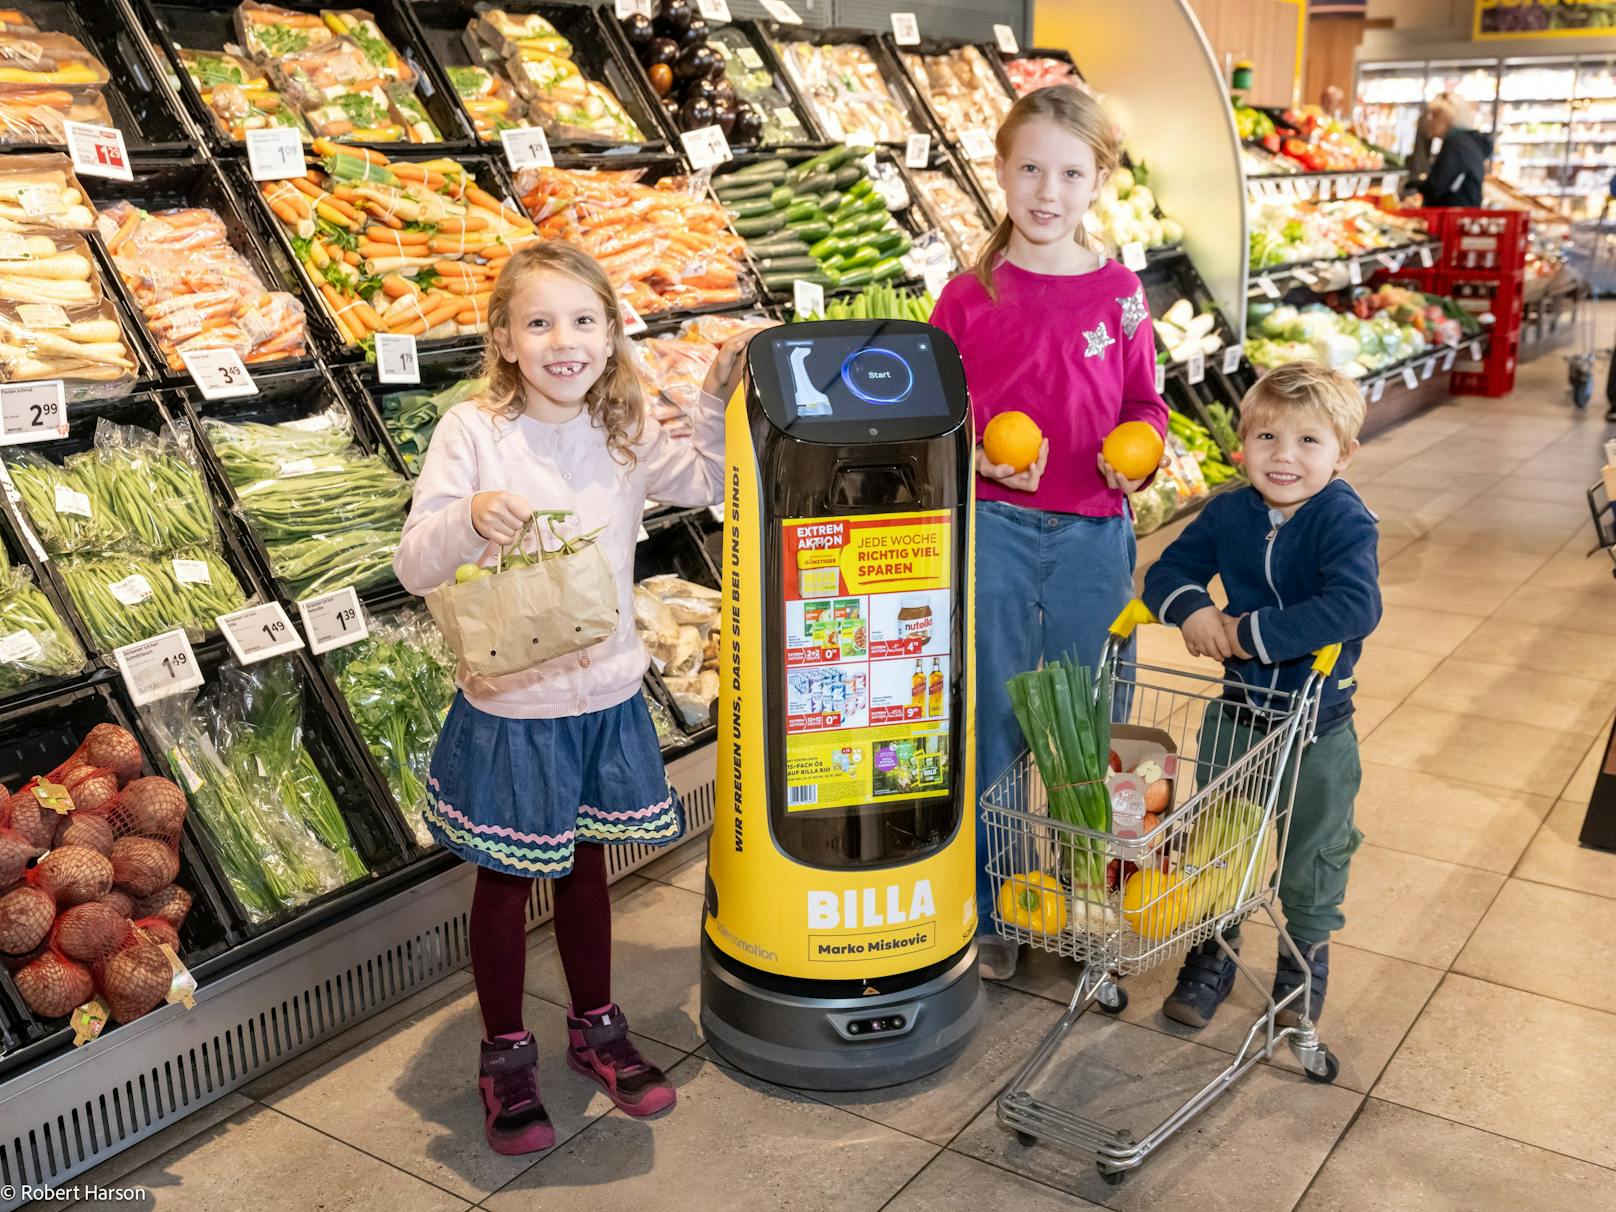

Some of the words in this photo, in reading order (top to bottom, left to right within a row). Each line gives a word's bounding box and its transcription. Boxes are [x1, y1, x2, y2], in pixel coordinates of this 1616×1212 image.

[868, 370, 892, 380] Start
[732, 465, 740, 522] SIND!
[797, 523, 844, 538] EXTREM
[798, 534, 843, 549] AKTION
[858, 536, 888, 549] JEDE
[890, 533, 937, 546] WOCHE
[732, 526, 740, 567] UNS
[858, 549, 910, 562] RICHTIG
[911, 546, 940, 558] VIEL
[858, 562, 913, 577] SPAREN
[732, 570, 740, 603] BEI
[732, 606, 741, 637] SIE
[905, 619, 933, 632] nutella
[732, 641, 741, 692] DASS
[732, 695, 743, 740] UNS,
[733, 742, 743, 815] FREUEN
[734, 818, 744, 852] WIR
[807, 879, 937, 929] BILLA
[818, 943, 865, 954] Marko
[868, 933, 927, 952] Miskovic
